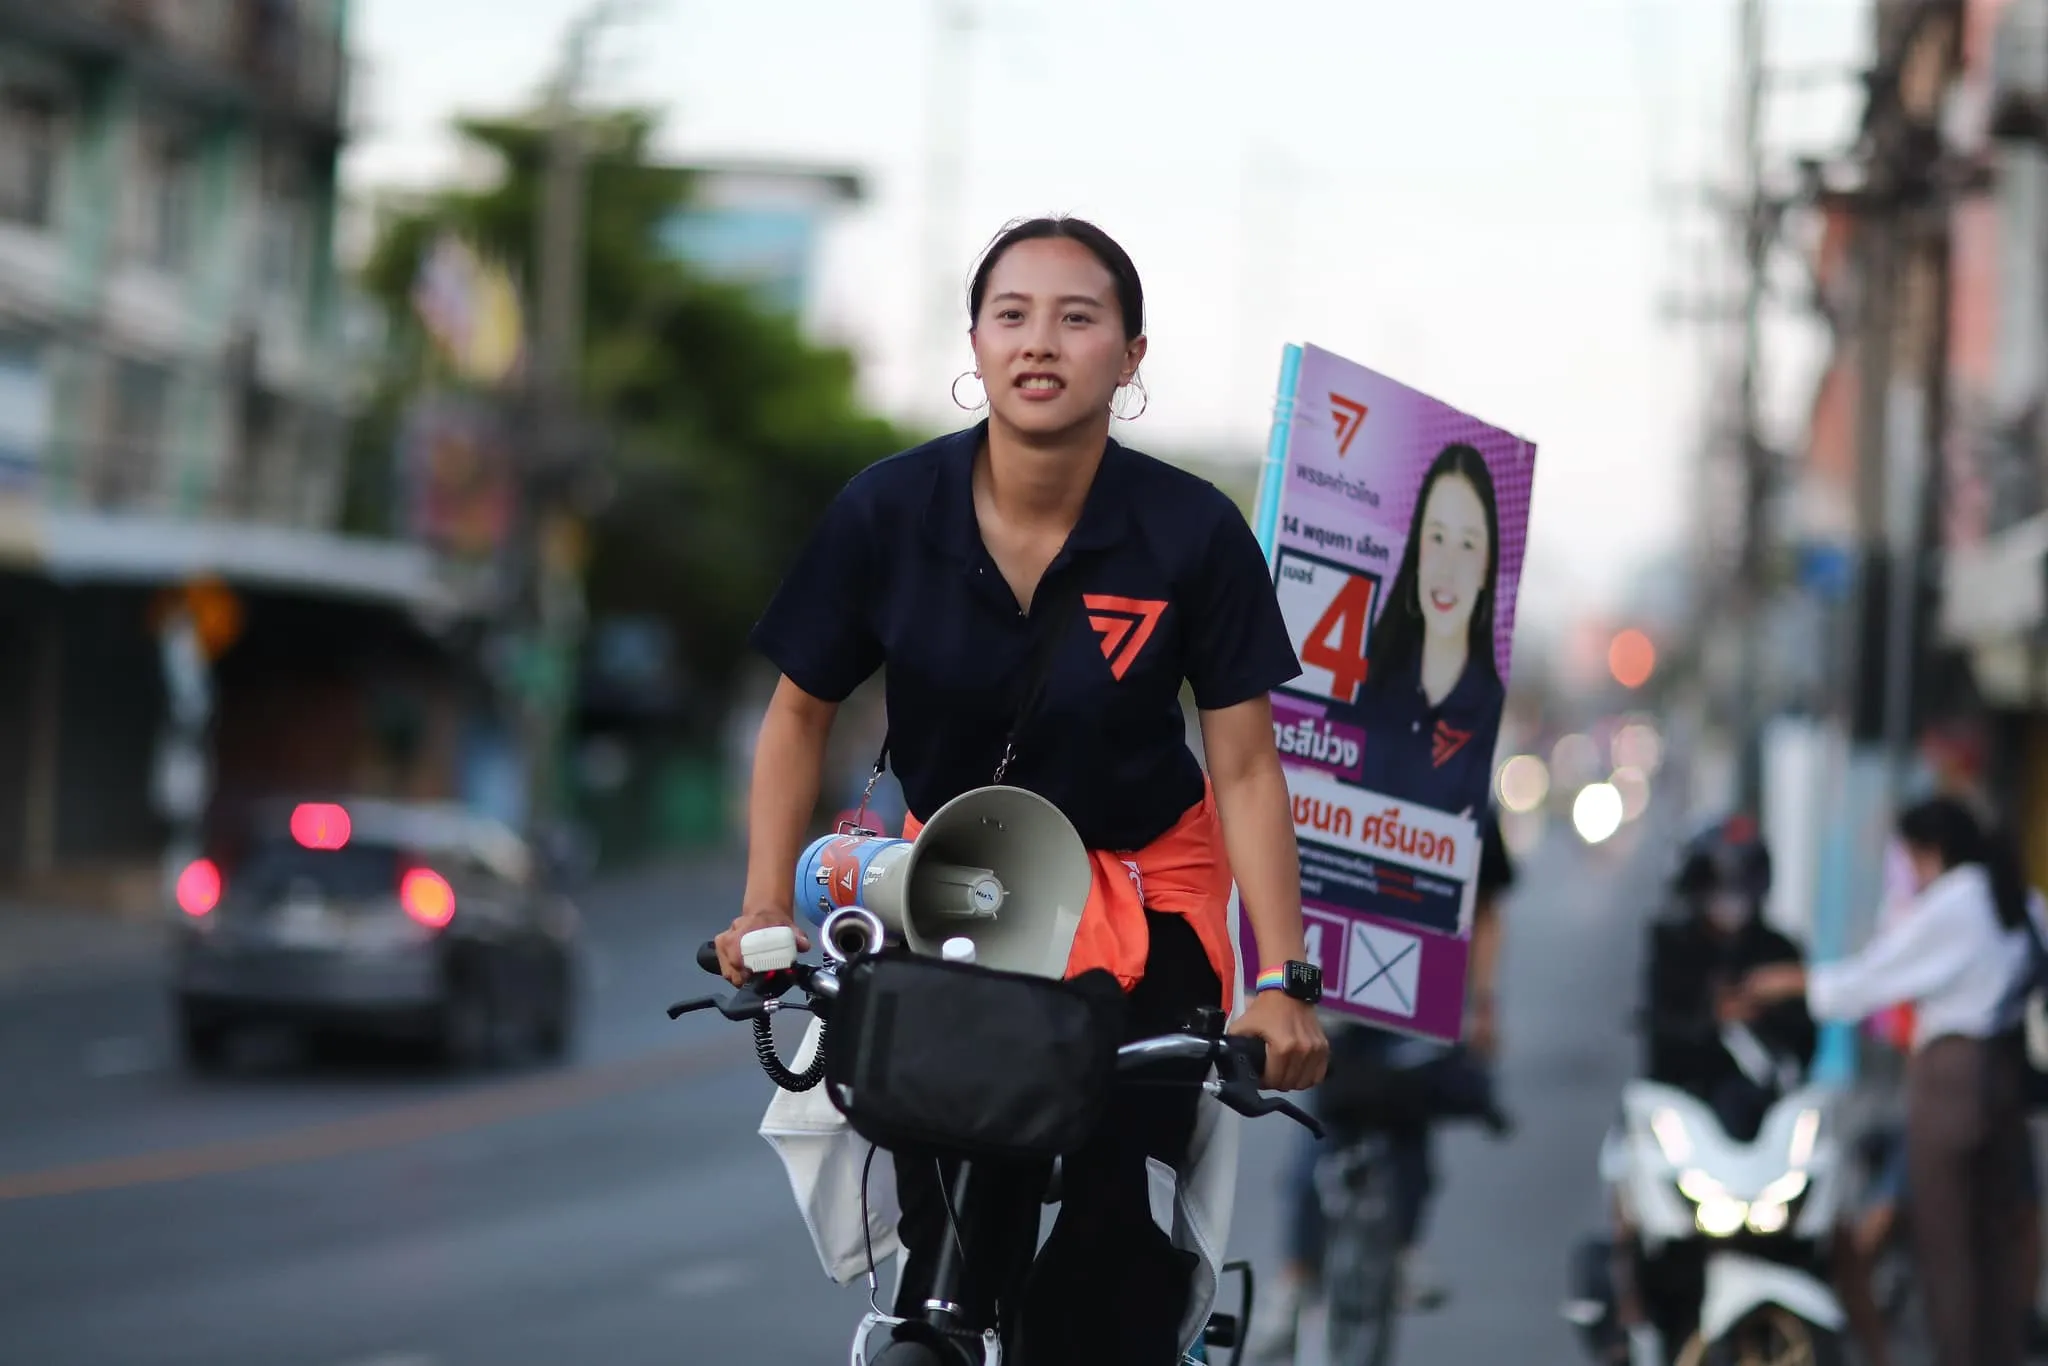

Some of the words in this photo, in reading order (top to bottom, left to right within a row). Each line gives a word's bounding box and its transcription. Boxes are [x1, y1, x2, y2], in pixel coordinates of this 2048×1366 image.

[1282, 514, 1299, 536] 14
[1283, 564, 1315, 584] เบอร์
[1301, 574, 1369, 703] 4
[1360, 806, 1456, 867] ศรีนอก
